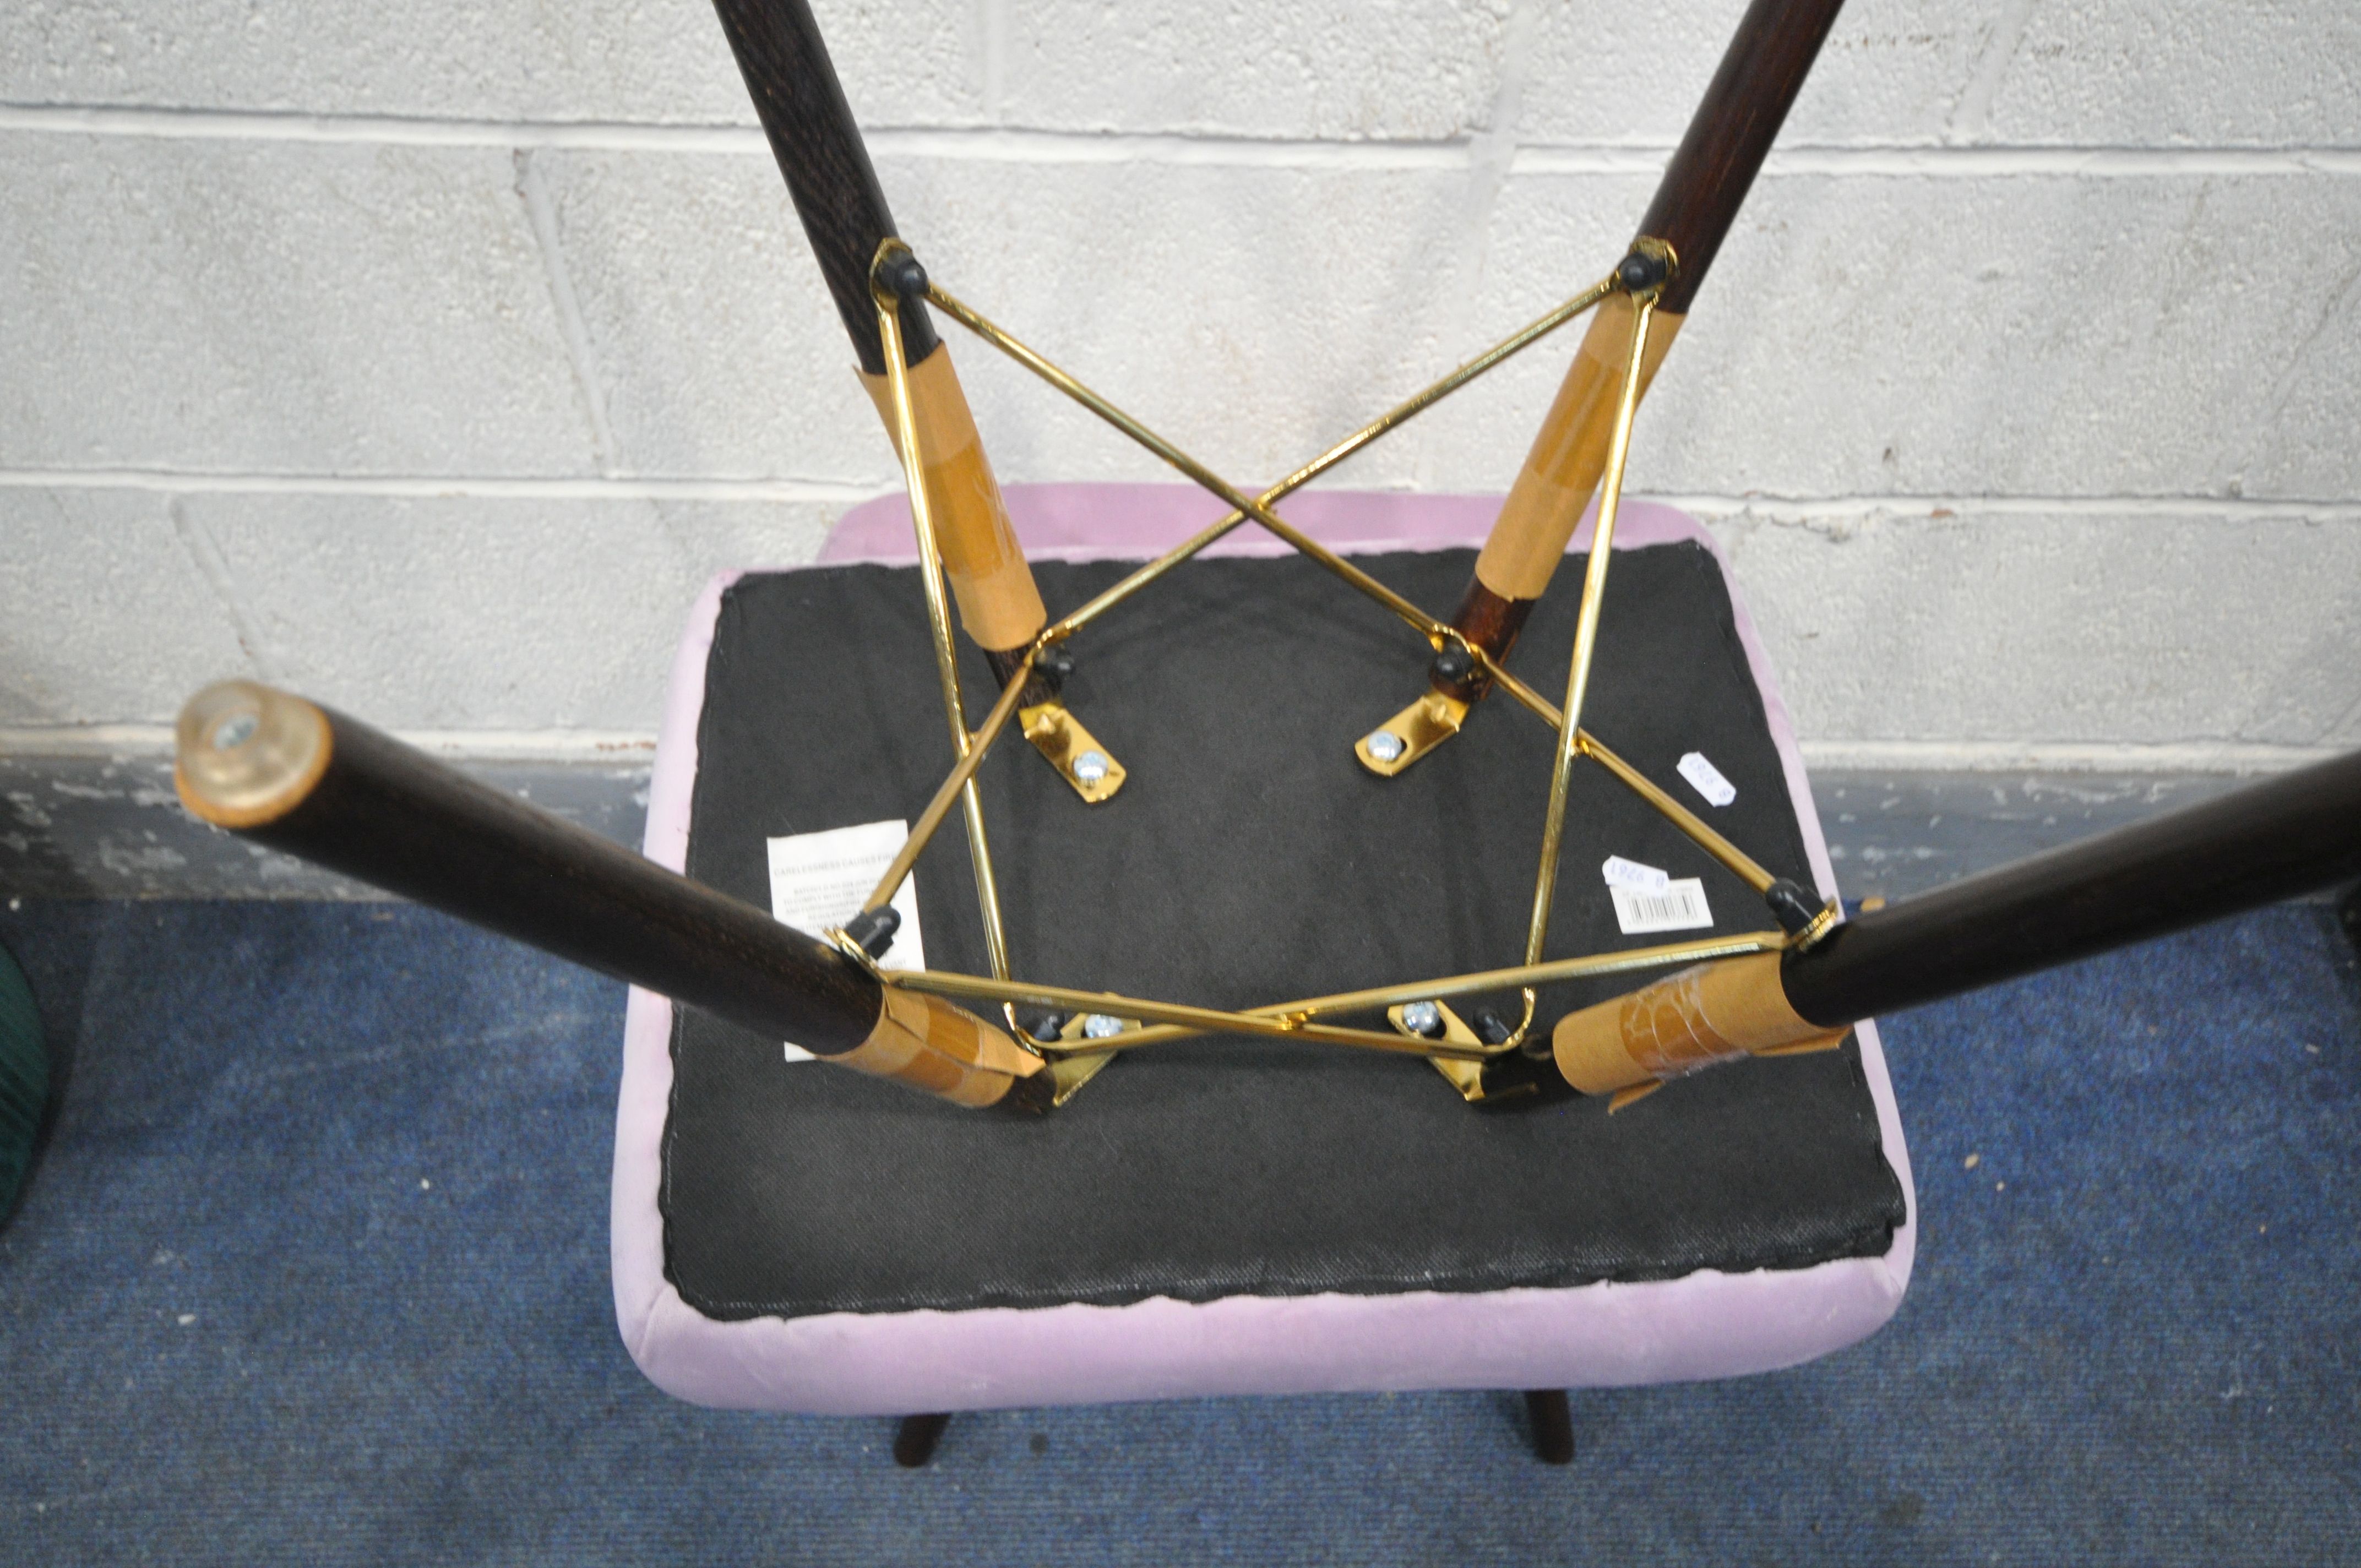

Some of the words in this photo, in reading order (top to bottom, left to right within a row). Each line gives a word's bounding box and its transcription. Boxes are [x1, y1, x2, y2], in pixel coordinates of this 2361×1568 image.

[1688, 758, 1718, 785] 9761
[1719, 788, 1731, 798] B
[774, 859, 841, 876] CARELESSNESS
[842, 855, 877, 868] CAUSES
[1610, 862, 1644, 882] 9761
